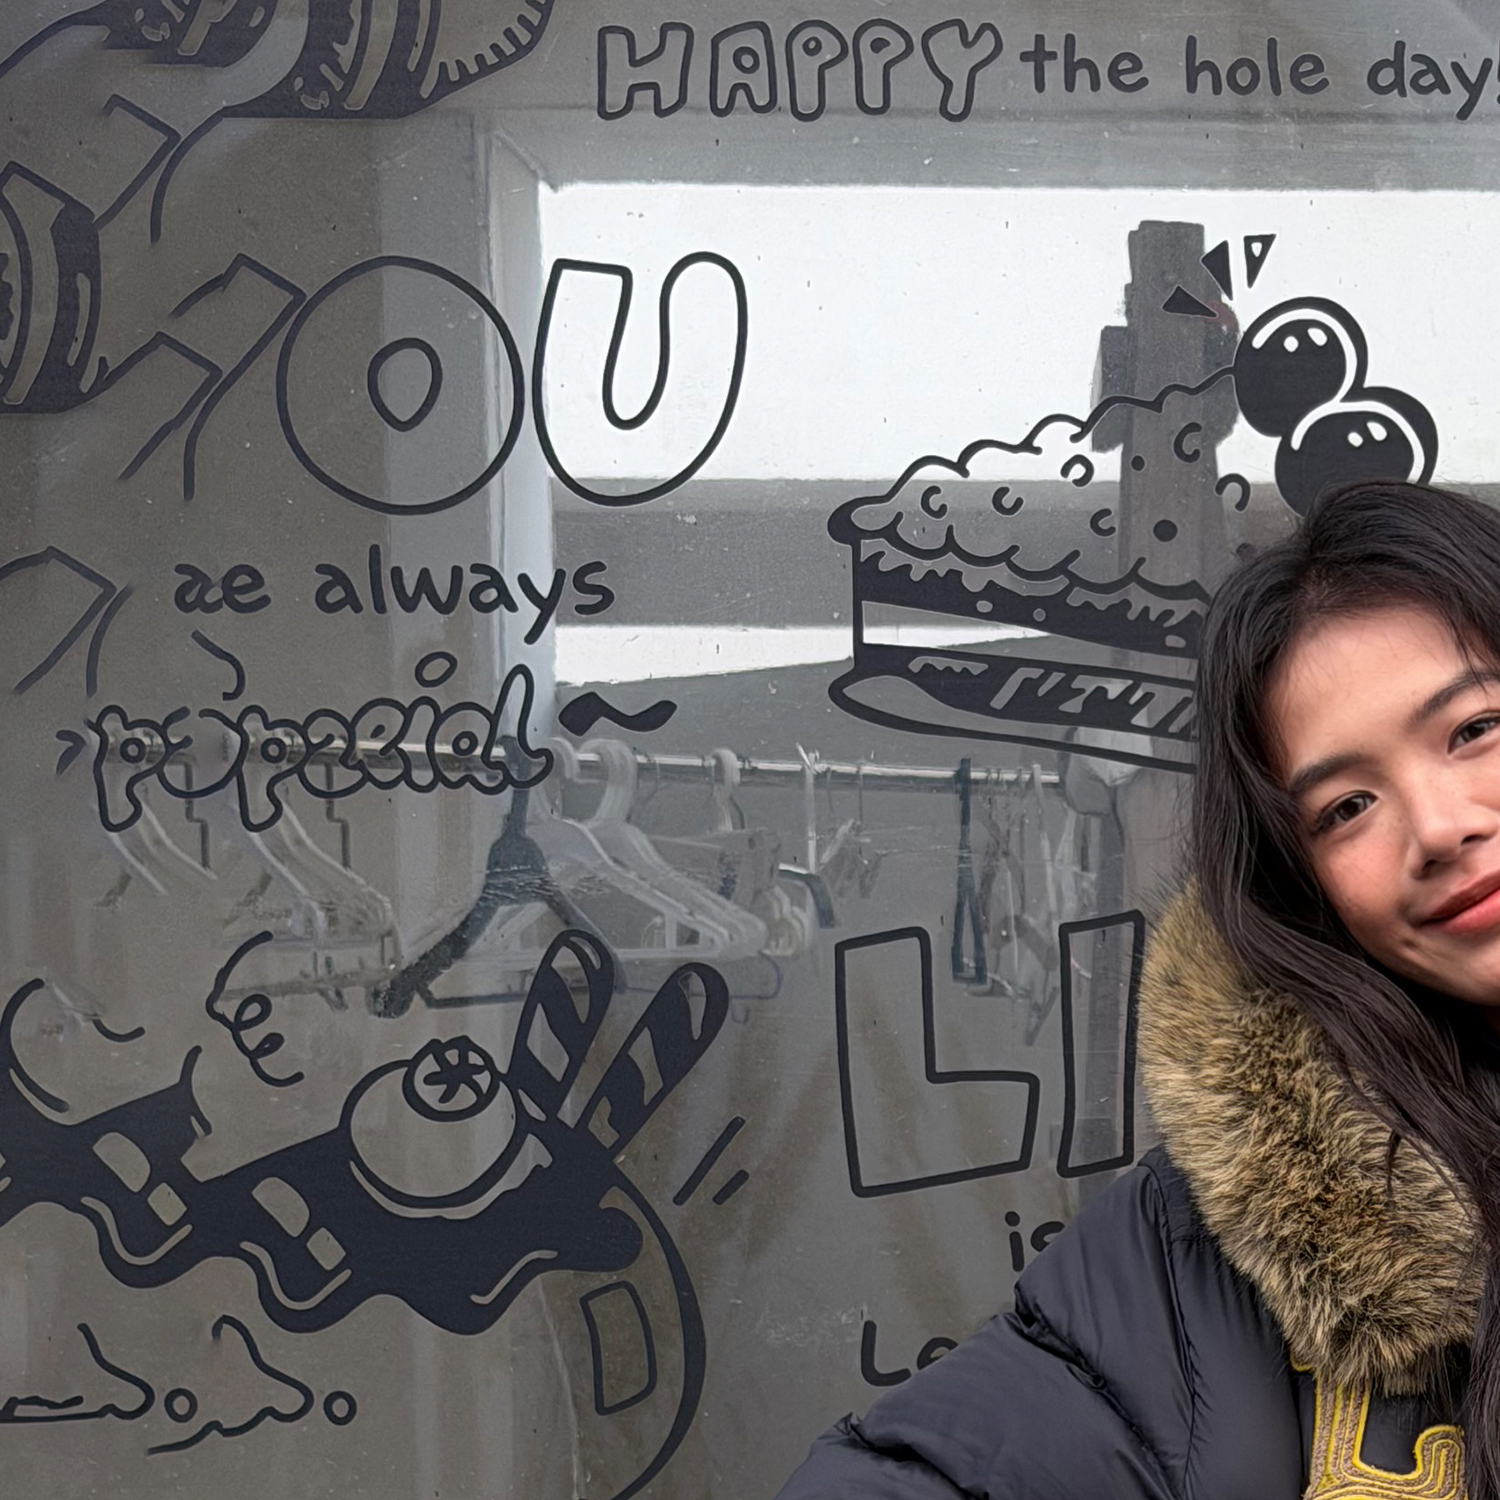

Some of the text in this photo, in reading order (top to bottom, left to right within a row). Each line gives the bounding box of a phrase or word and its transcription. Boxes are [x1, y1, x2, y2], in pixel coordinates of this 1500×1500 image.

[598, 19, 1003, 122] HAPPY
[1019, 33, 1150, 97] the
[1184, 35, 1331, 97] hole
[314, 545, 615, 644] always
